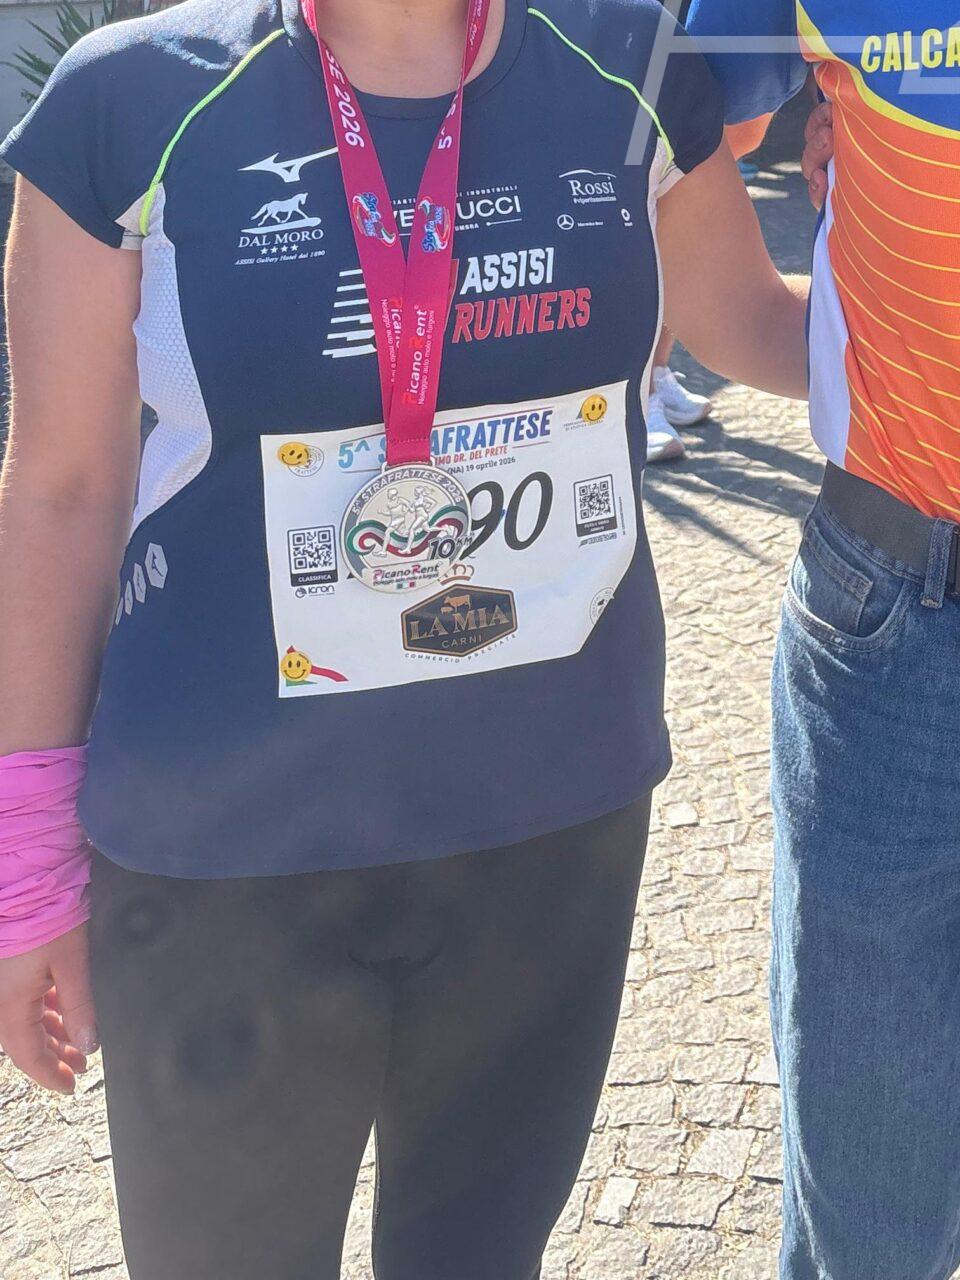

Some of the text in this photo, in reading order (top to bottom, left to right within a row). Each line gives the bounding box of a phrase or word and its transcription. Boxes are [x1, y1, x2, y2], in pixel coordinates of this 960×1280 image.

[333, 83, 365, 148] 2026
[568, 176, 615, 196] Rossi
[238, 228, 324, 248] DAL MORO
[459, 247, 555, 296] ASSISI
[451, 287, 592, 344] RUNNERS
[470, 450, 482, 460] DEL
[485, 445, 508, 456] PRETE
[466, 463, 475, 472] 19
[475, 459, 498, 471] aprile
[499, 456, 516, 467] 2026
[361, 468, 445, 502] STRAFRATTESE
[442, 478, 464, 503] 2026
[459, 470, 555, 561] 90
[430, 538, 456, 560] 10
[298, 574, 332, 583] CLASSIFICA
[409, 604, 510, 641] LA MIA
[441, 635, 483, 649] CARNI
[404, 653, 461, 664] COMMERCIO
